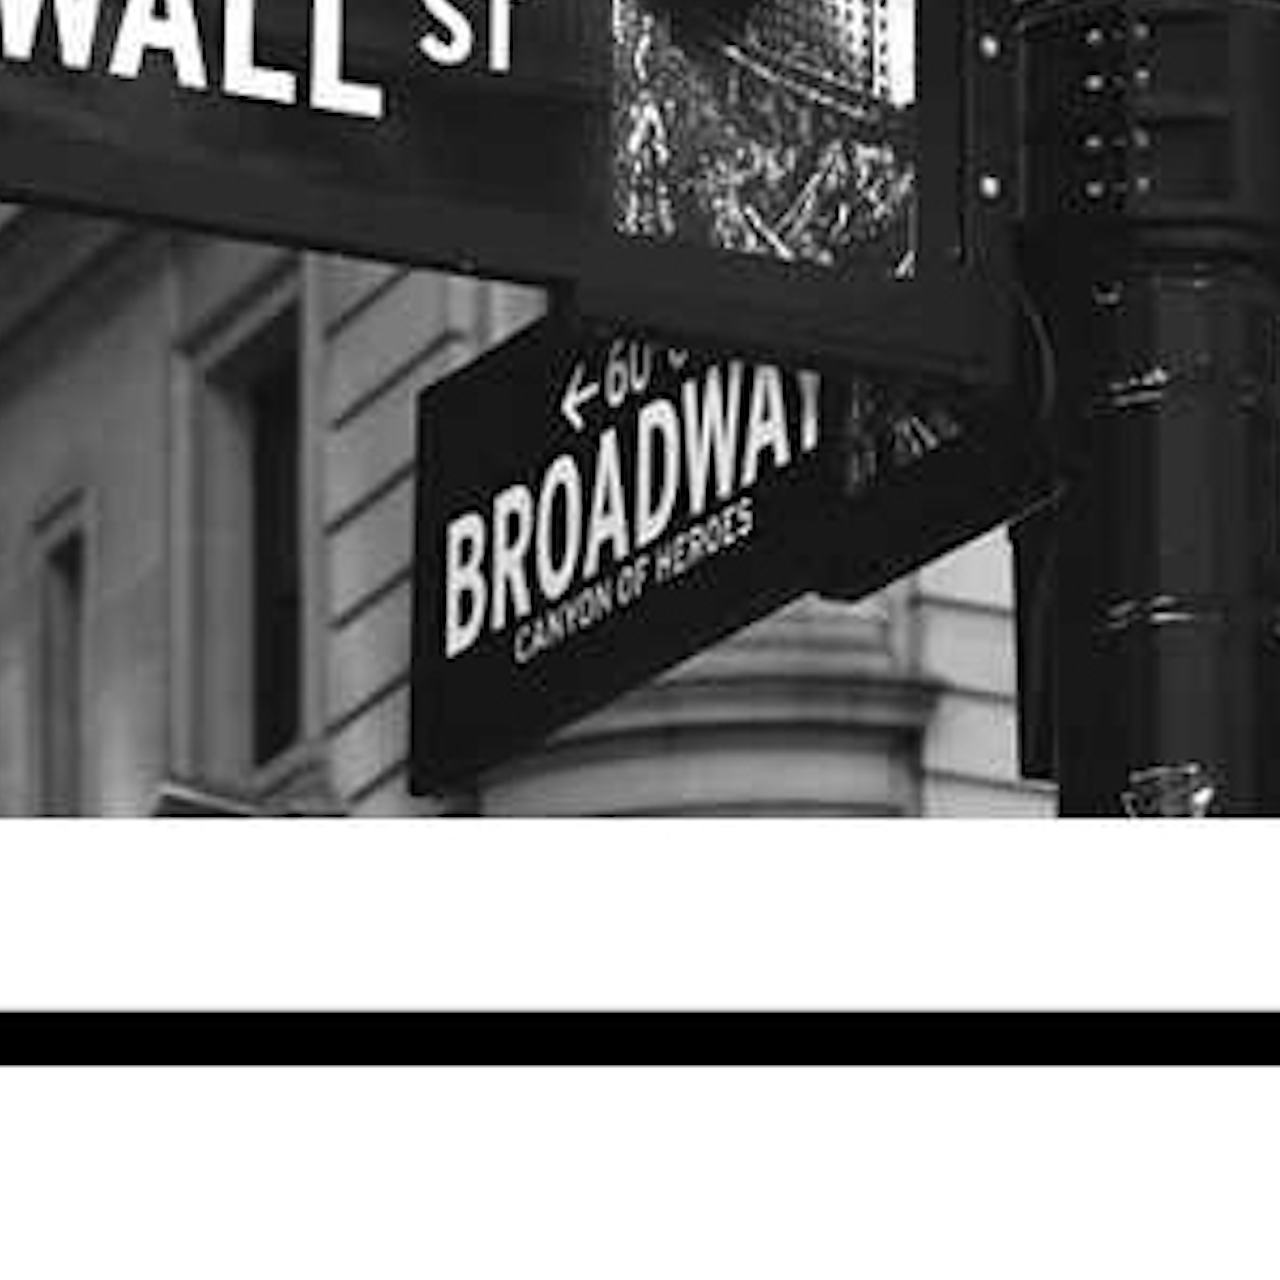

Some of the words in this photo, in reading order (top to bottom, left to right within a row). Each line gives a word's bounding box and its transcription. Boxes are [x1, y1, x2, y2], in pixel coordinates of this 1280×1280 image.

[513, 576, 613, 664] CANYON
[616, 553, 652, 606] OF
[653, 495, 755, 583] HEROES
